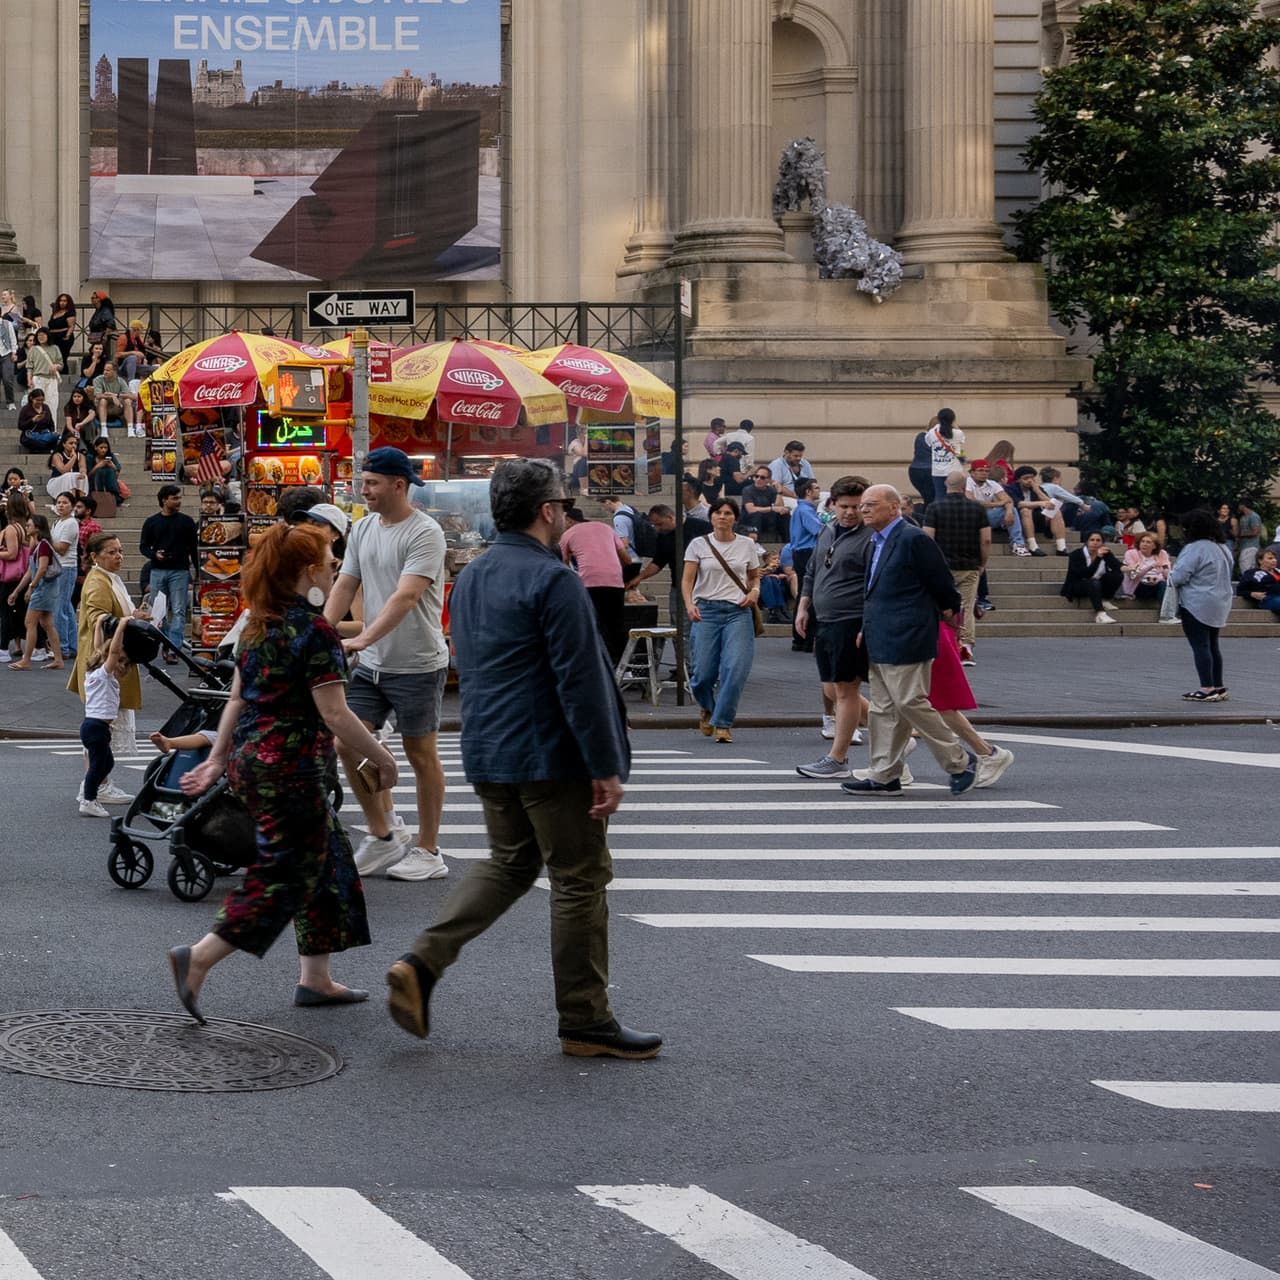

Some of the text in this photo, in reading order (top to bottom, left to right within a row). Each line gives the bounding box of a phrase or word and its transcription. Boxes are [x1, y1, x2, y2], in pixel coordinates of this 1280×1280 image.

[173, 15, 420, 52] ENSEMBLE
[324, 301, 401, 316] ONE WAY
[201, 356, 238, 369] NIKAS
[454, 370, 491, 384] NIKAS
[378, 393, 396, 404] Beef
[396, 397, 409, 407] Hot
[409, 398, 428, 410] Dogs
